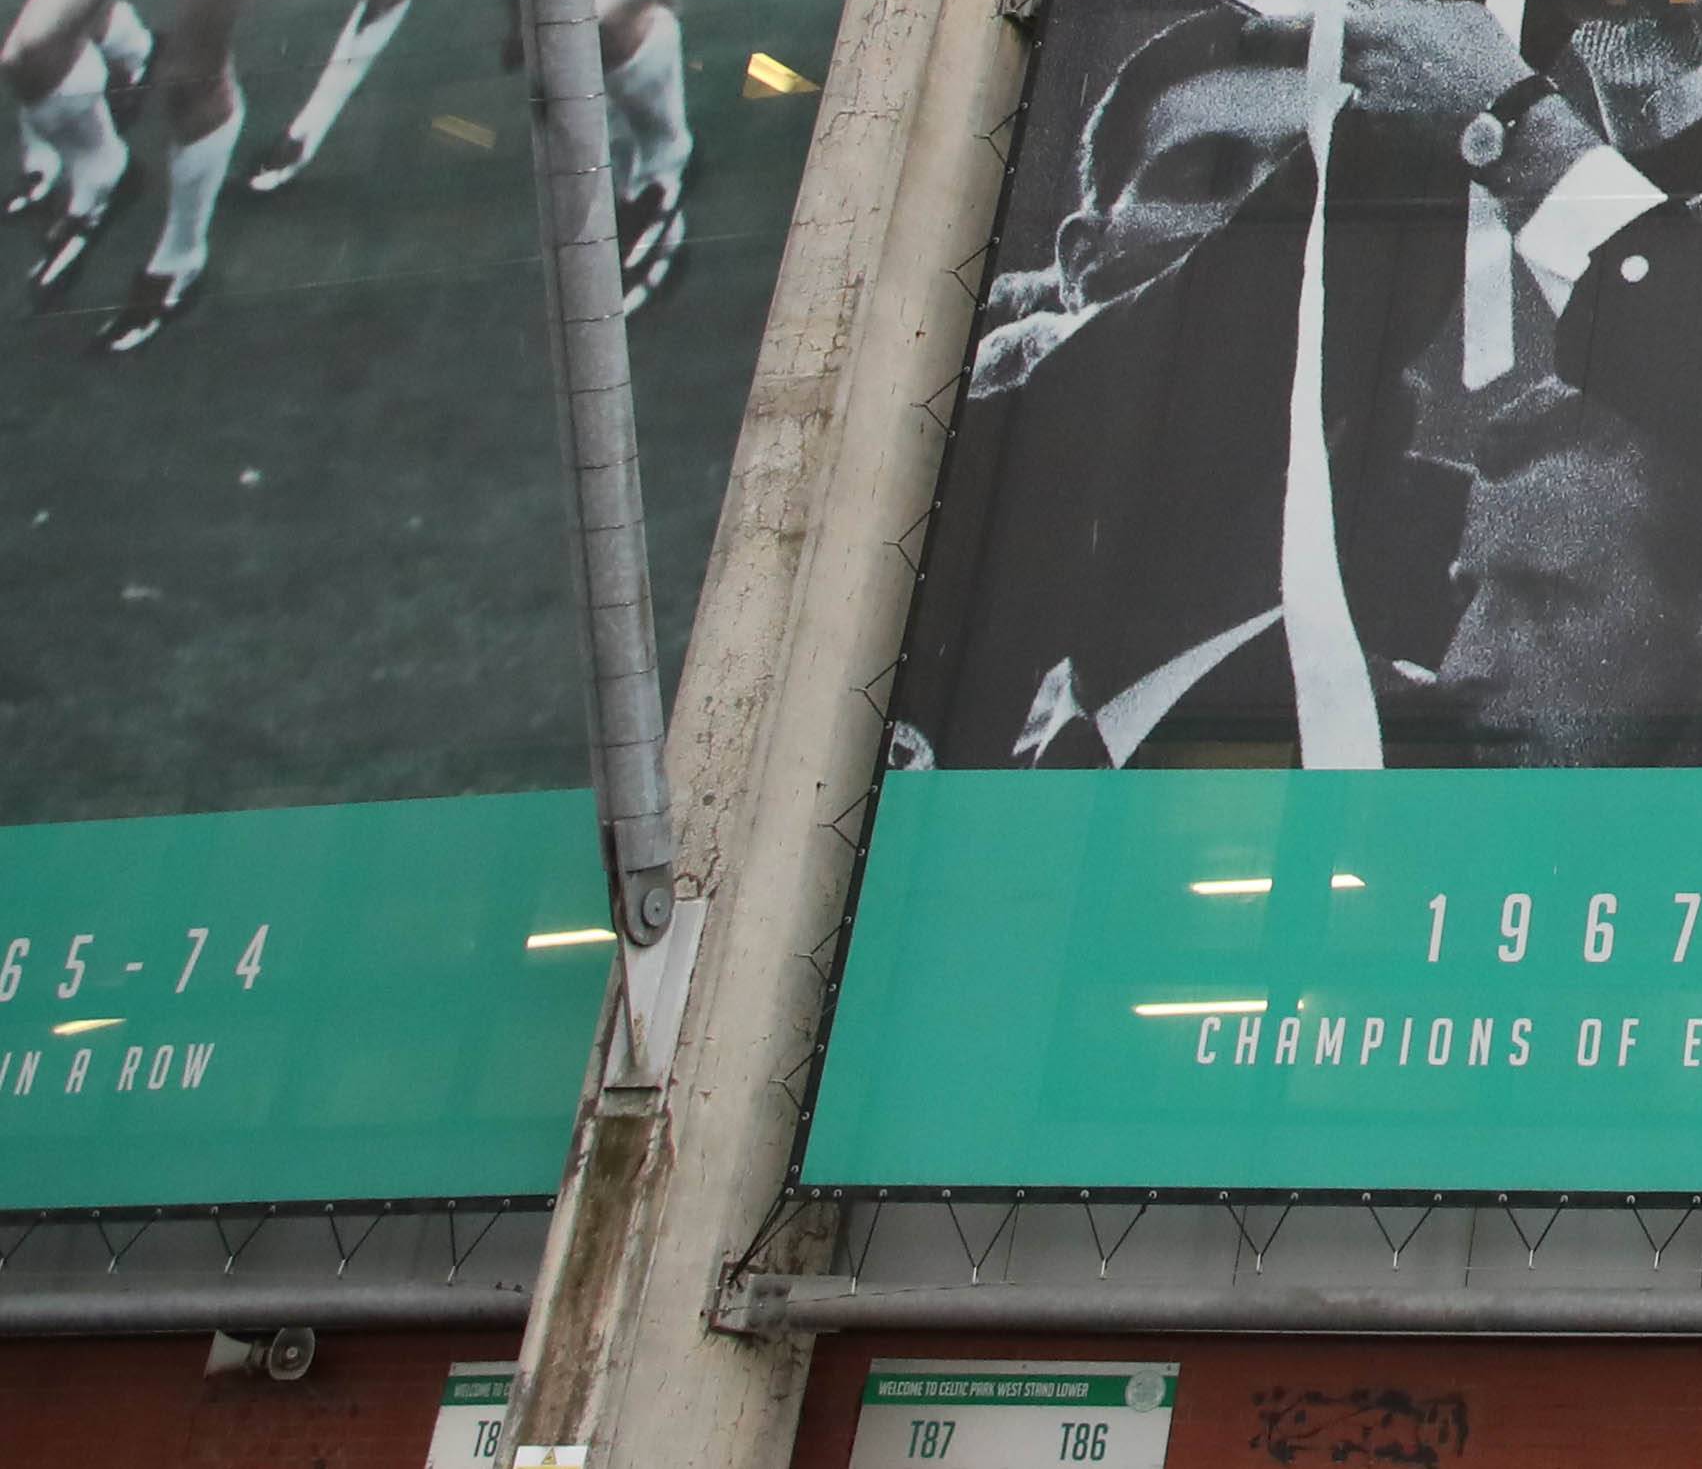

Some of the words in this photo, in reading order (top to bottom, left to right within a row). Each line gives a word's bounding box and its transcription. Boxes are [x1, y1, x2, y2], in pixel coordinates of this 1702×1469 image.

[1427, 892, 1702, 964] 1967
[0, 923, 270, 1003] 65-74
[1196, 1016, 1534, 1067] CHAMPIONS
[1575, 1017, 1641, 1068] OF
[64, 1047, 93, 1094] A
[116, 1043, 215, 1092] ROW
[879, 1380, 924, 1396] WELCOME
[925, 1381, 938, 1396] TO
[938, 1381, 968, 1396] CELTIC
[969, 1382, 996, 1397] PARK
[997, 1382, 1022, 1397] WEST
[1023, 1382, 1055, 1398] STAND
[1056, 1382, 1089, 1398] LOWER
[473, 1420, 502, 1458] T8
[907, 1420, 955, 1460] T87
[1059, 1422, 1109, 1462] T86
